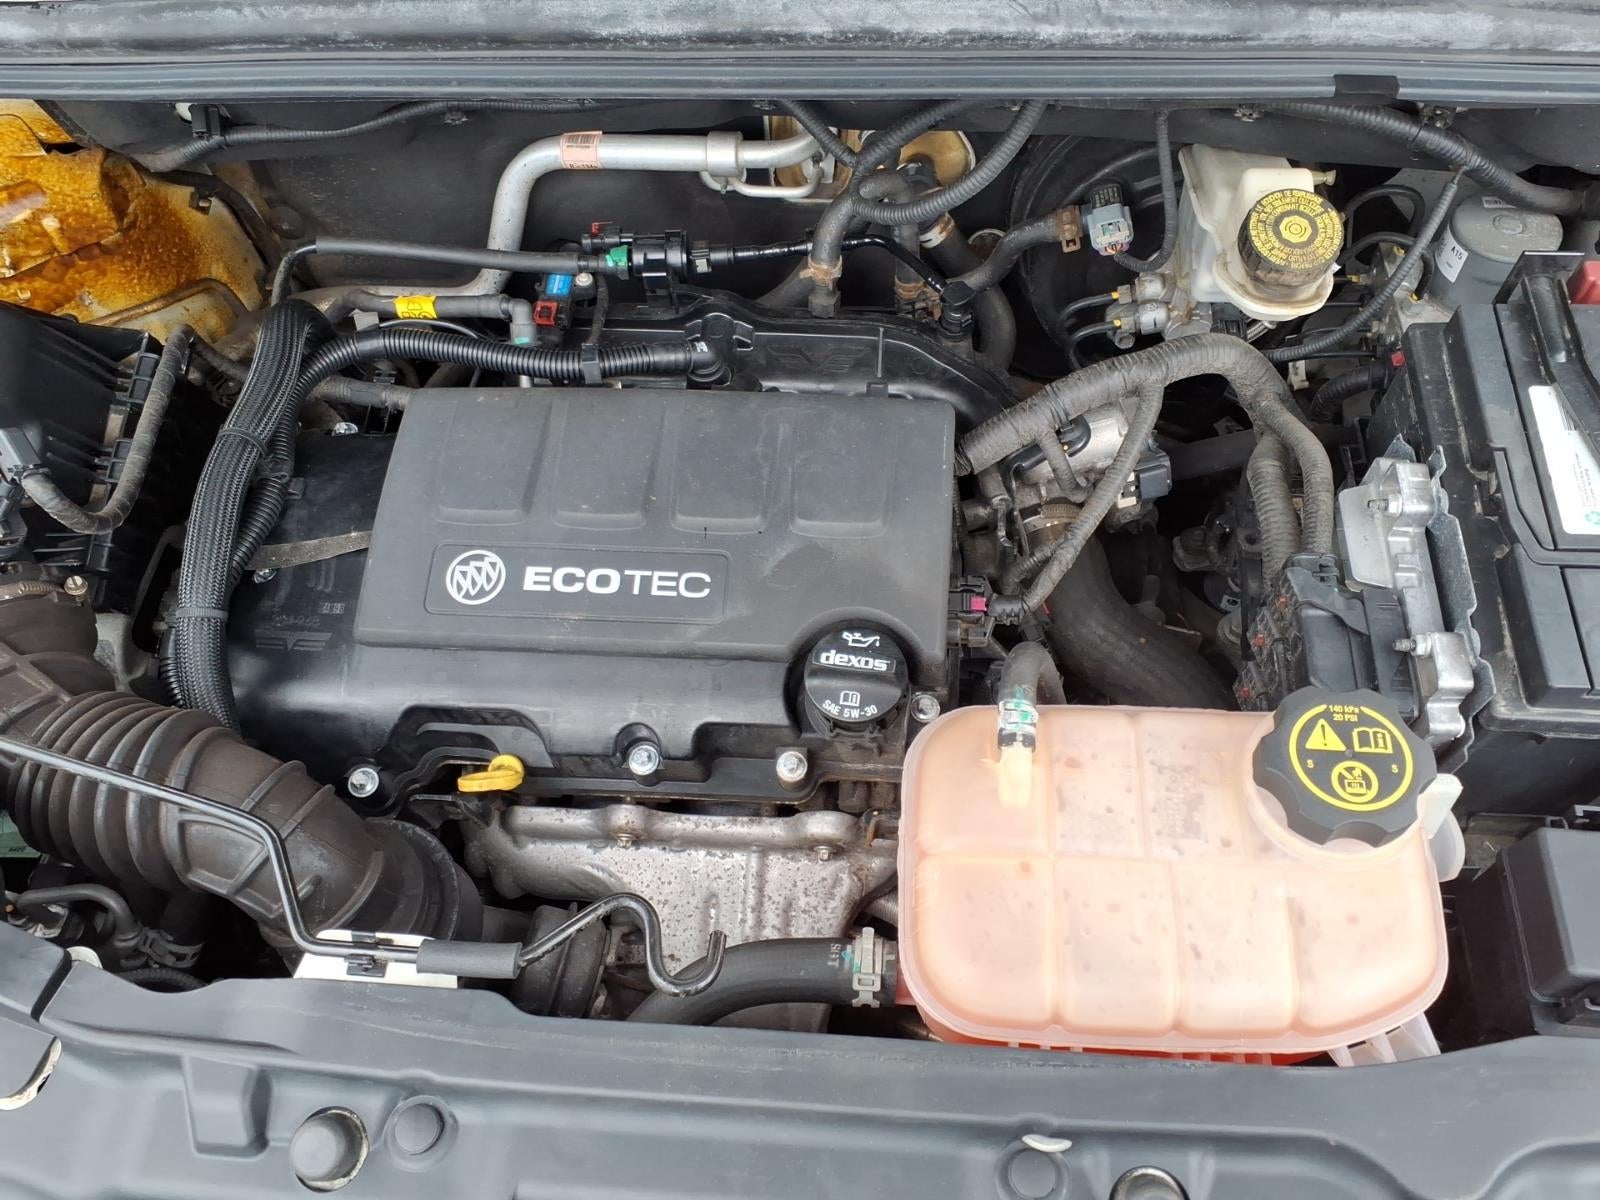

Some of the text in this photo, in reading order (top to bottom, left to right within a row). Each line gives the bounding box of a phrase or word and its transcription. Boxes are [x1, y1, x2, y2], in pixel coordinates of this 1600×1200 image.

[522, 566, 712, 598] ECOTEC
[820, 649, 891, 672] dexos
[822, 699, 878, 719] SAE 5W-30
[1328, 705, 1360, 714] 140 kPa
[1333, 713, 1358, 722] 20 PSI
